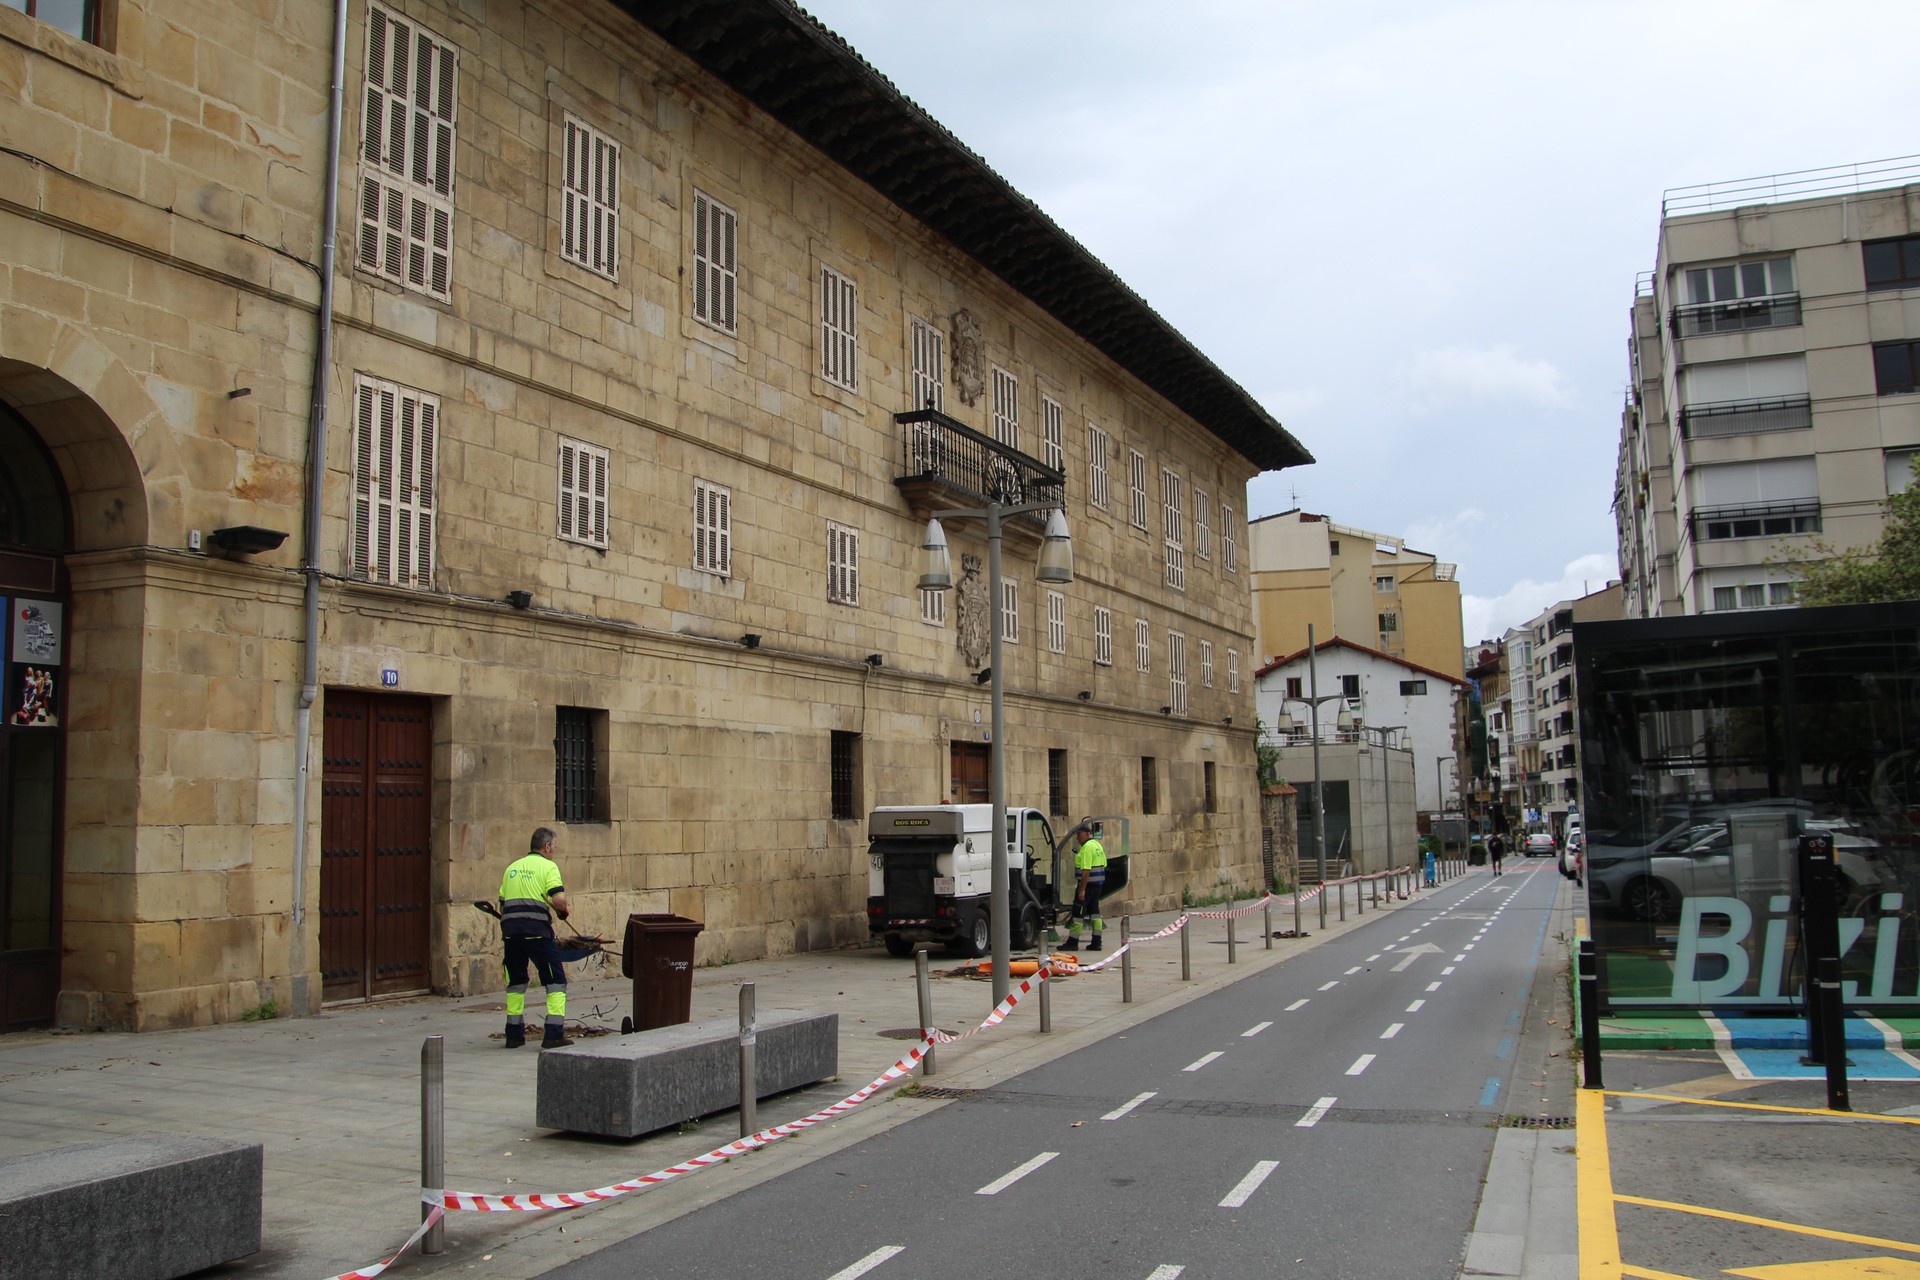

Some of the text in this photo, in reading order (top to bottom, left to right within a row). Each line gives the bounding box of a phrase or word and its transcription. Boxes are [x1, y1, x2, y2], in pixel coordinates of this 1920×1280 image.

[386, 671, 397, 684] 10
[872, 856, 883, 869] 40
[1671, 892, 1920, 999] Bii
